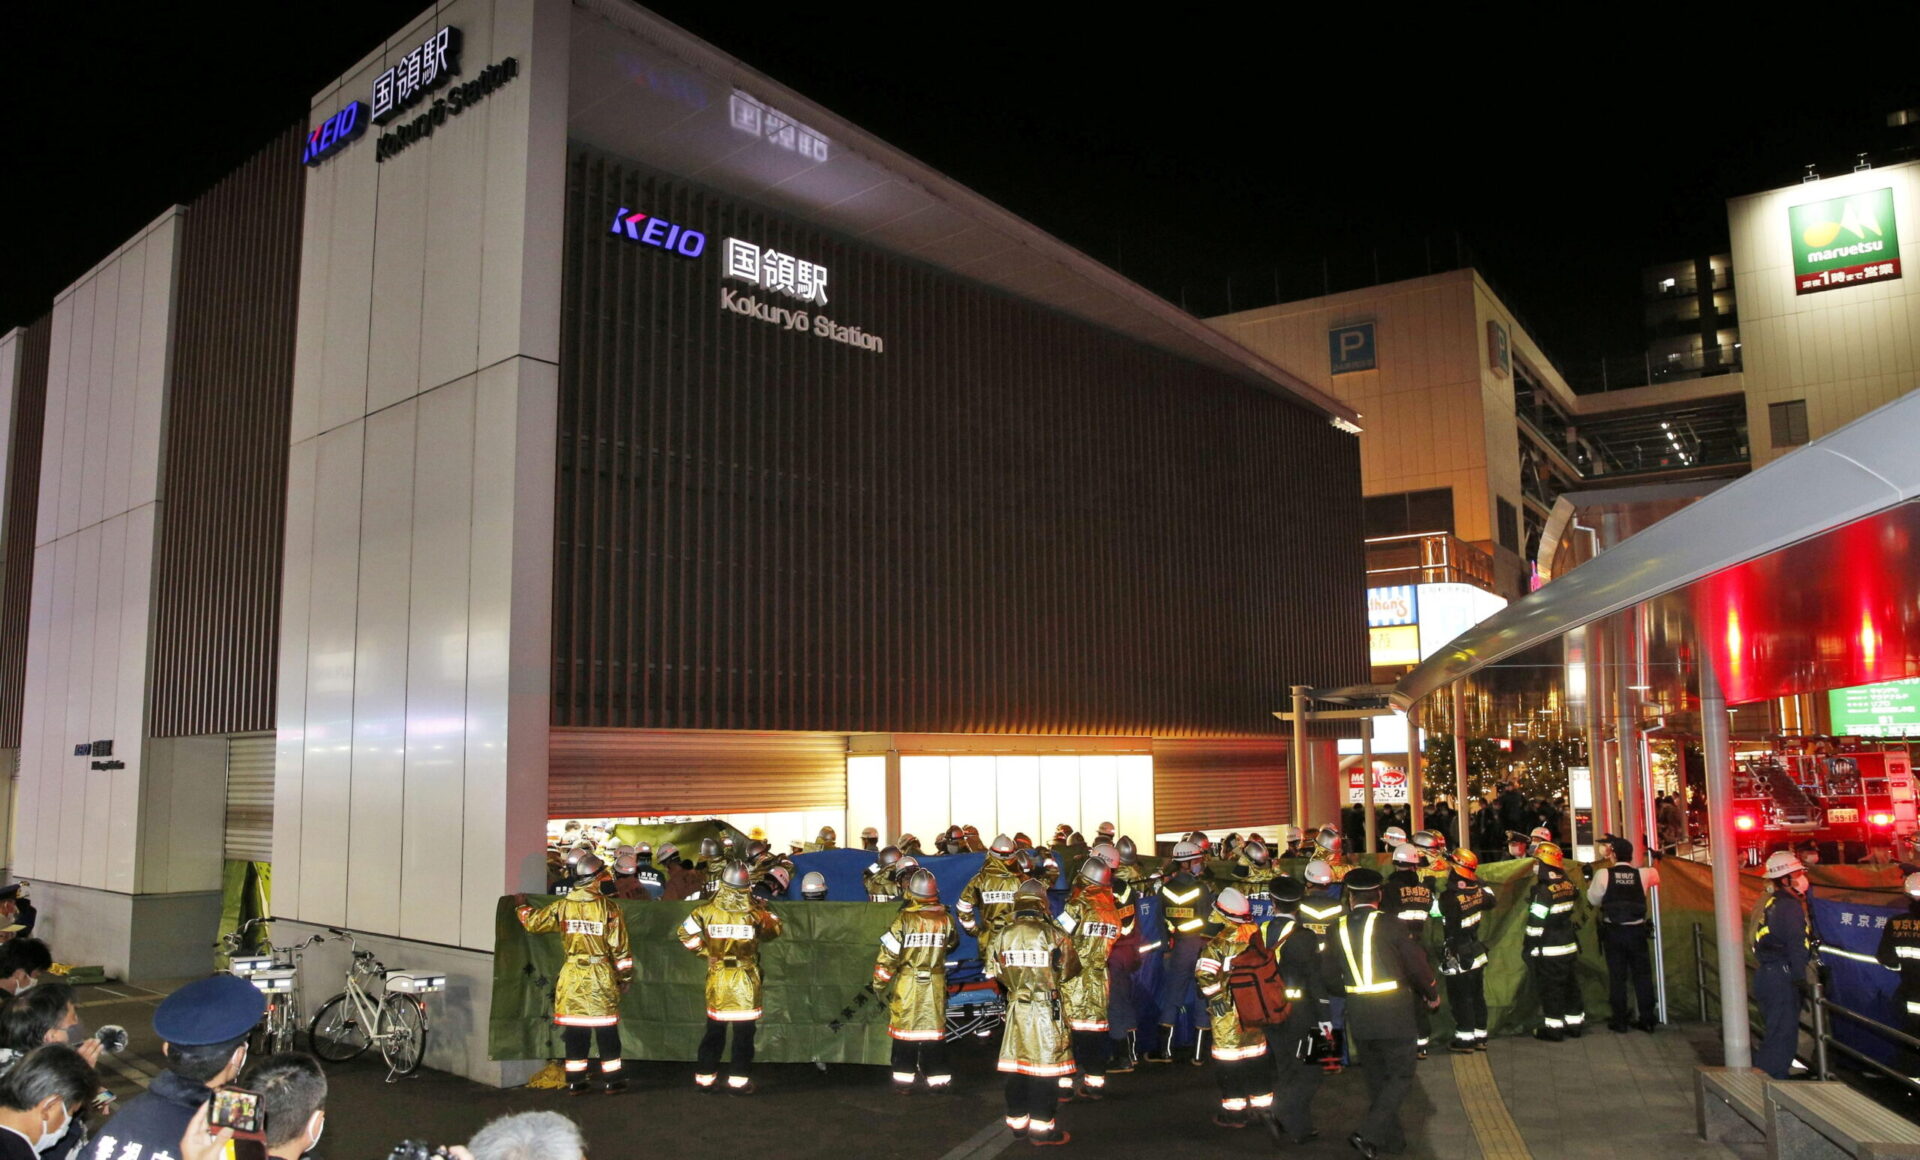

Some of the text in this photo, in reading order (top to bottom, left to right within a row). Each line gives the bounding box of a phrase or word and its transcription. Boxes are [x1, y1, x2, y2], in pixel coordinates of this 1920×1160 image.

[371, 25, 449, 122] 国領駅
[303, 101, 358, 164] KEIO
[611, 207, 706, 258] KEIO
[1807, 240, 1884, 263] maruetsu
[723, 237, 828, 306] 国領駅
[813, 315, 884, 353] Station
[1340, 331, 1365, 361] P
